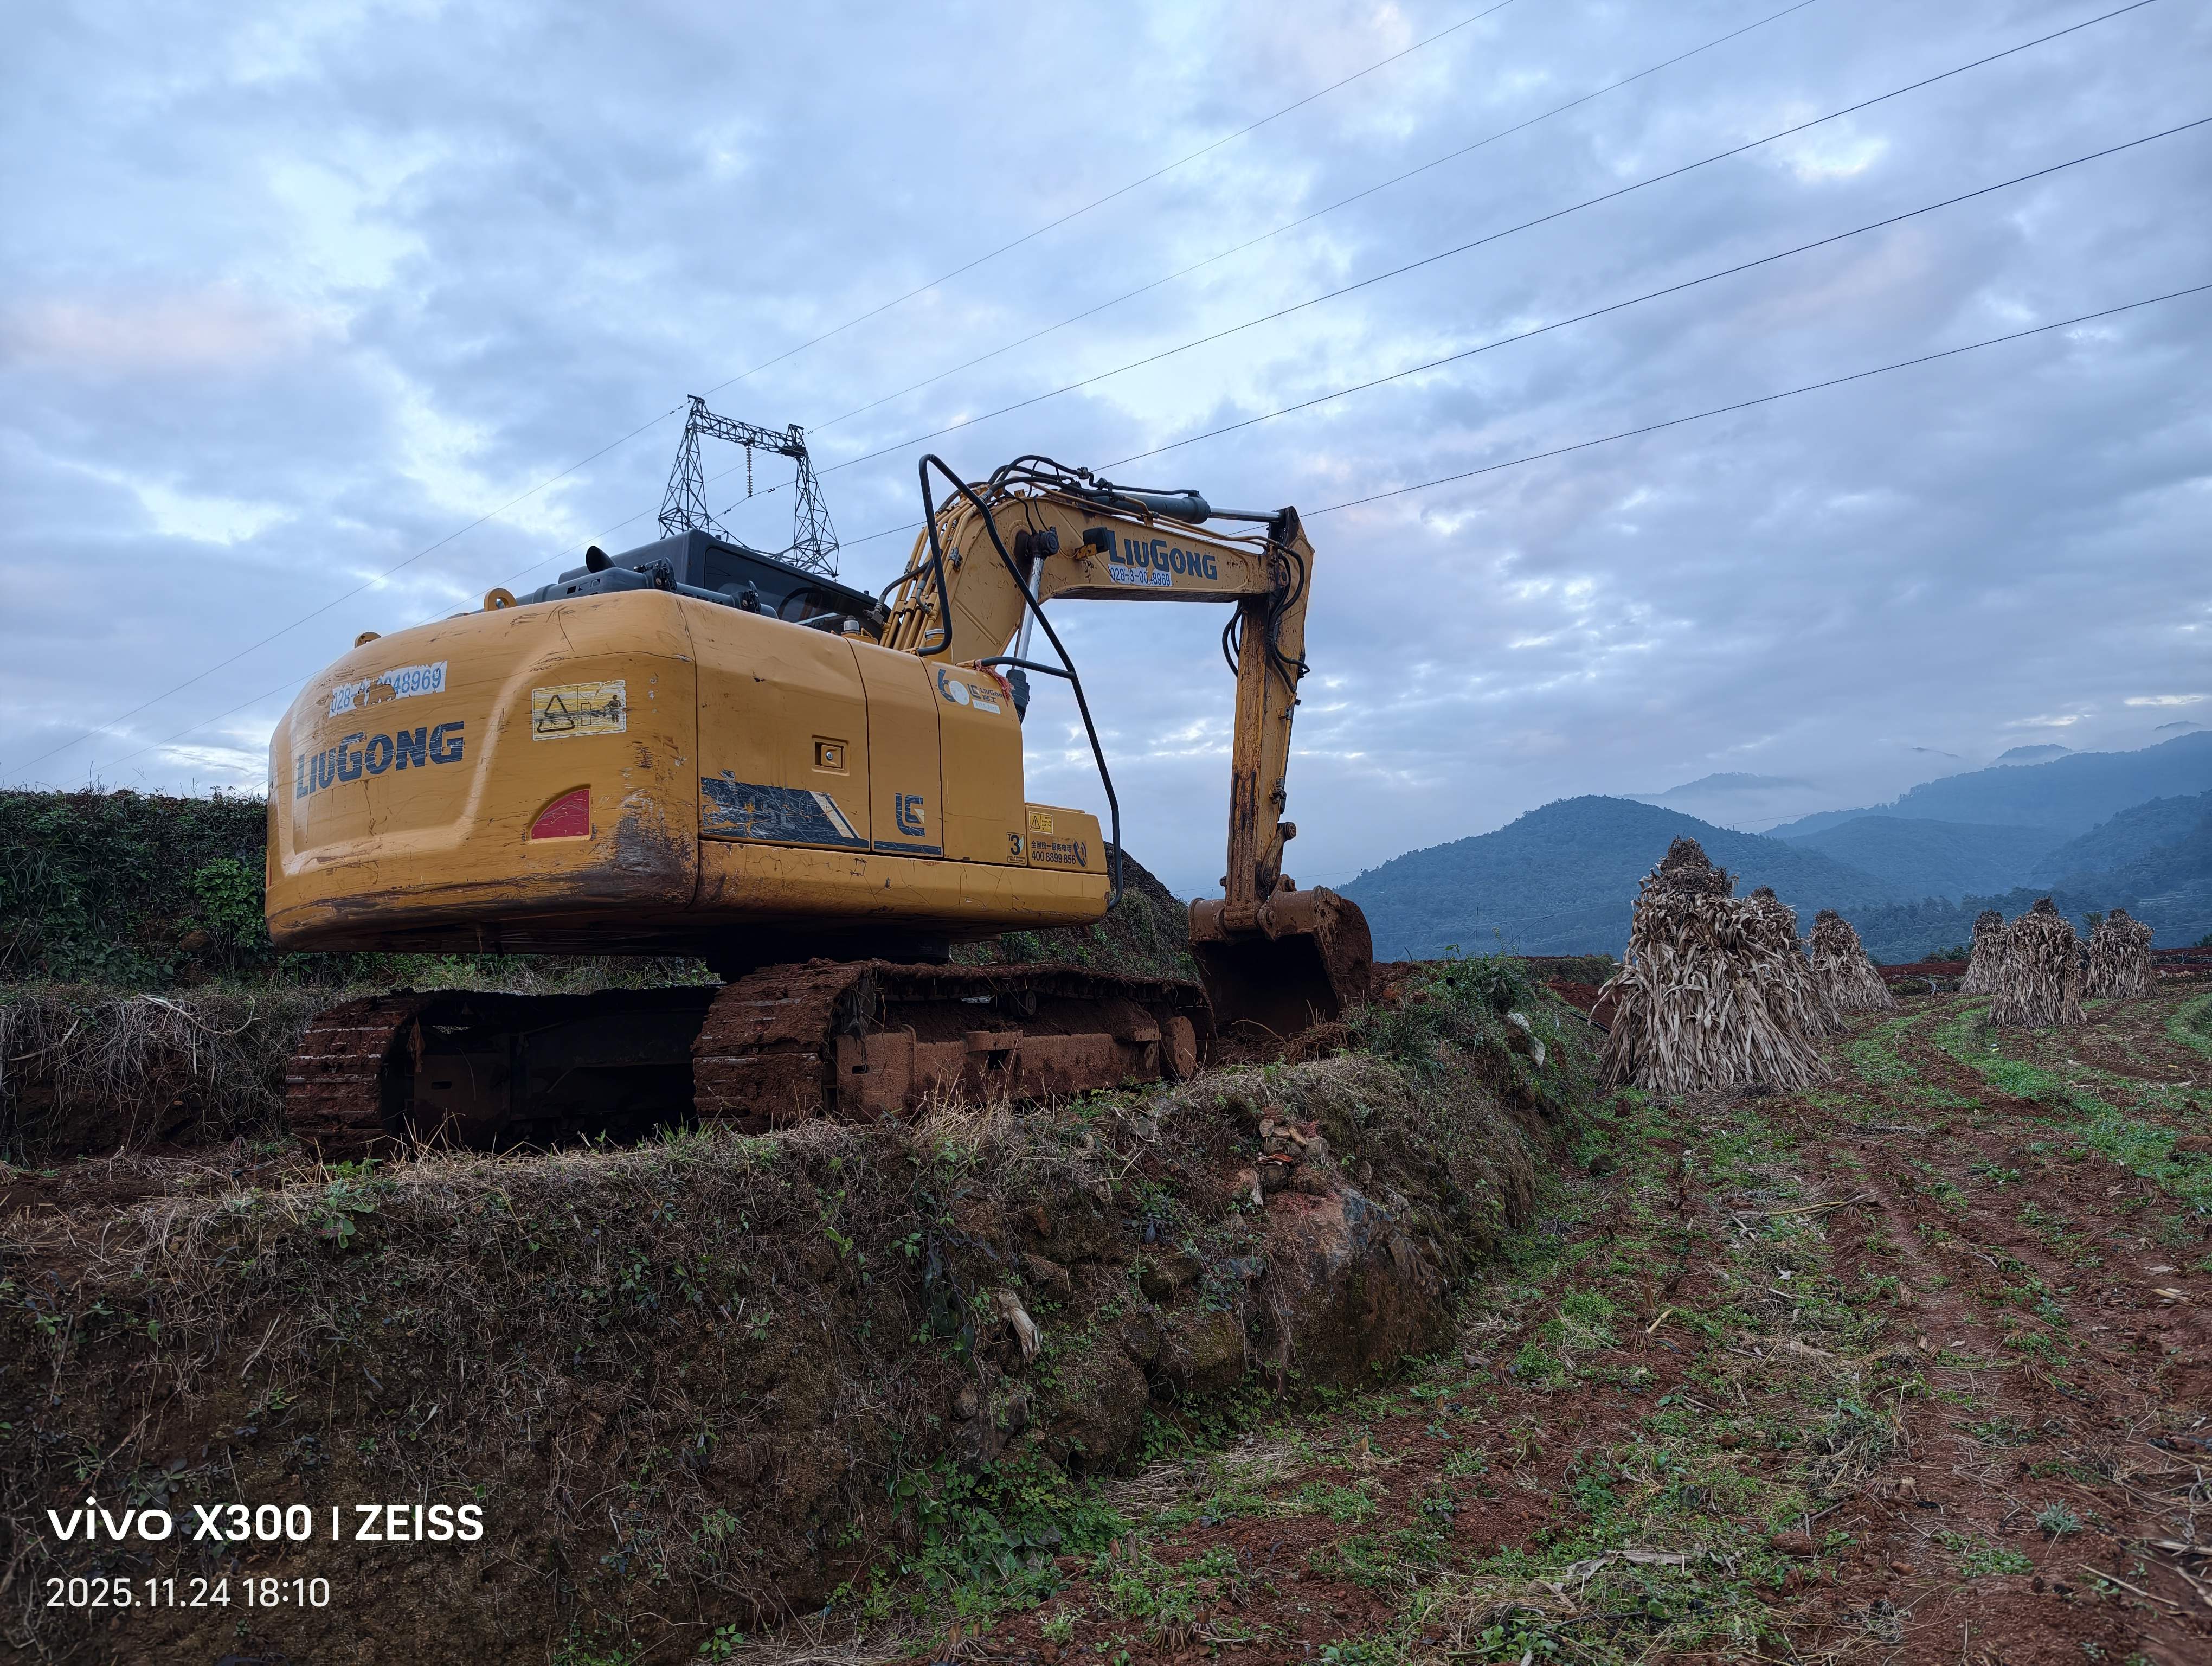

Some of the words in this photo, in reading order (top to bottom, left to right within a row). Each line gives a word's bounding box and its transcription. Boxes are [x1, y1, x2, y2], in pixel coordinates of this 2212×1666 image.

[297, 721, 465, 800] LIUGONG
[1031, 840, 1072, 852] 全国统一服务电话
[1031, 850, 1044, 861] 400
[1046, 852, 1062, 863] 8899
[1064, 854, 1076, 864] 856
